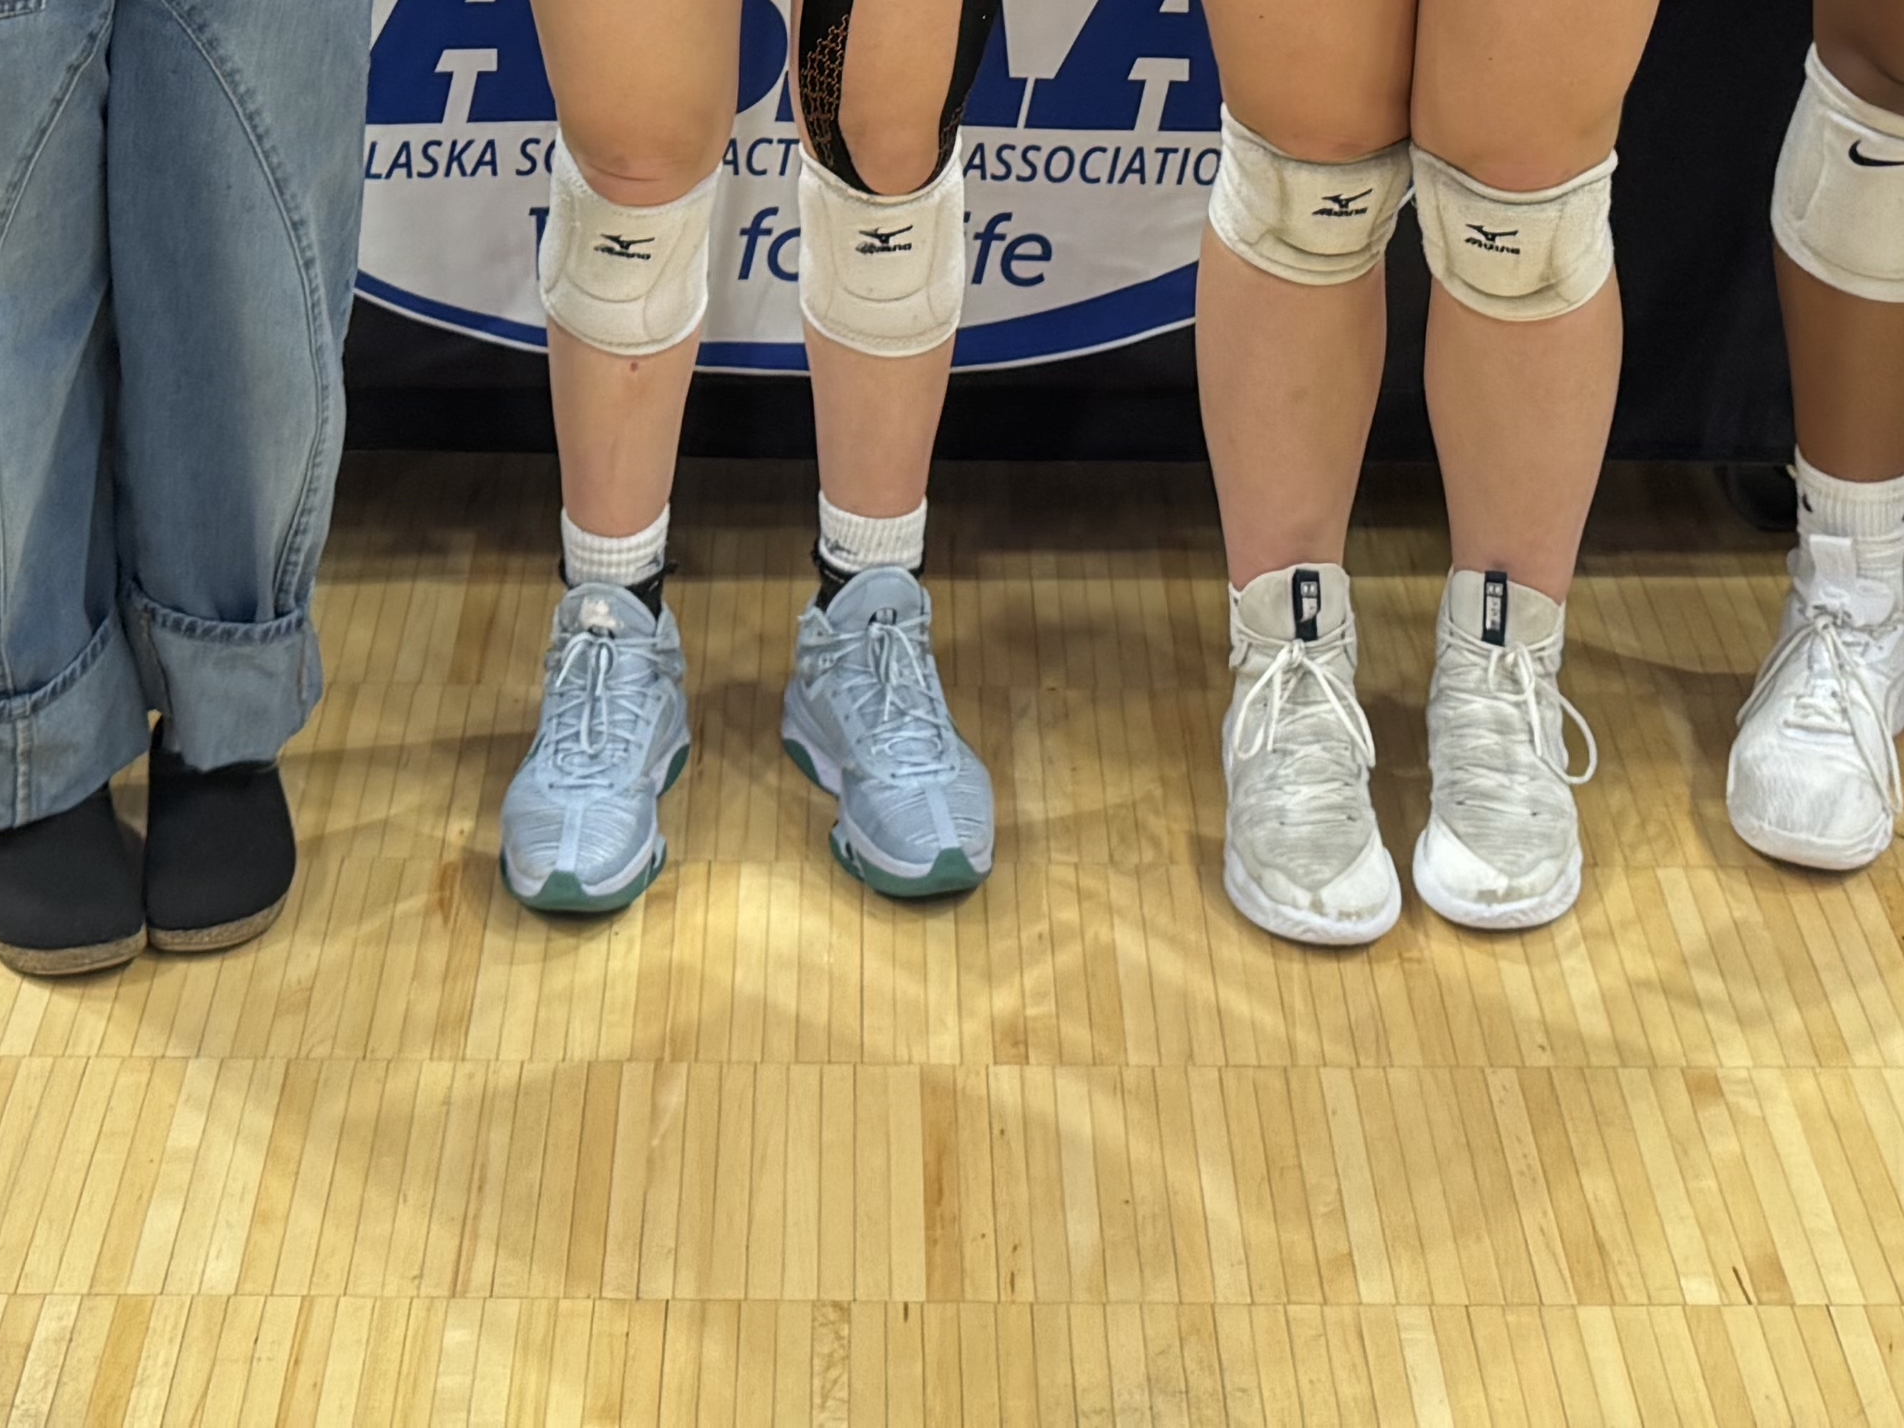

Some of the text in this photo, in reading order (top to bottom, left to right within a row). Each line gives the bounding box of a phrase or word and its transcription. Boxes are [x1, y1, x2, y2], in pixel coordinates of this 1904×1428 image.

[365, 138, 499, 180] LASKA
[963, 142, 1222, 187] ASSOCIATIO
[737, 207, 801, 282] fo
